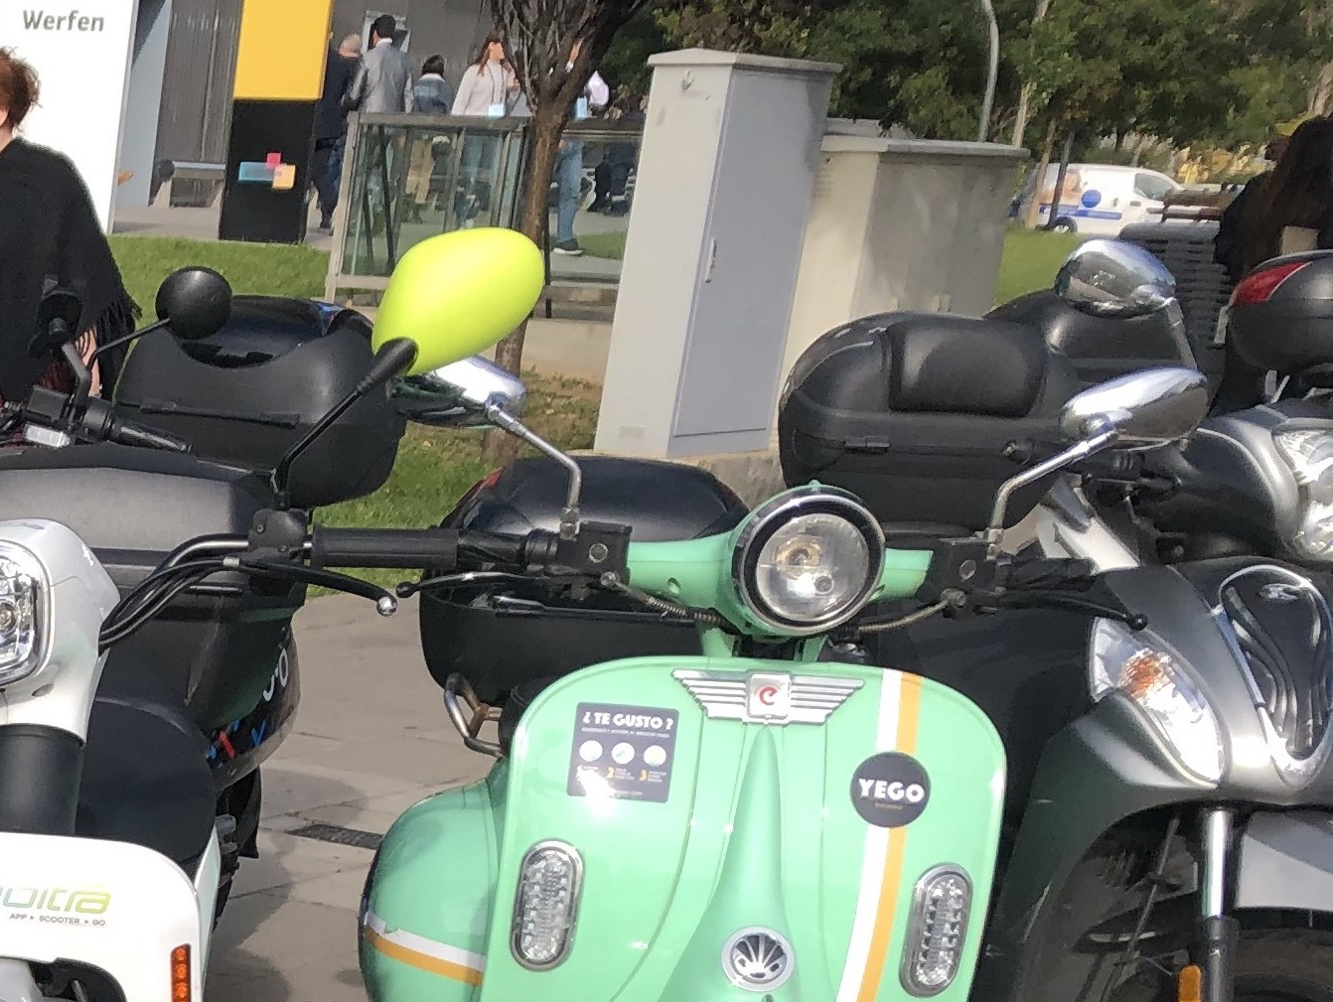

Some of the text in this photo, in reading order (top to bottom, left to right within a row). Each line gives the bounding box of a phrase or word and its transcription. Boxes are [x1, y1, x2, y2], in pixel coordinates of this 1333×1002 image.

[23, 9, 104, 32] Werfen
[594, 712, 611, 725] TE
[613, 713, 663, 729] GUSTO
[858, 778, 925, 803] YEGO
[9, 913, 28, 921] APP
[39, 915, 80, 925] SCOOTER
